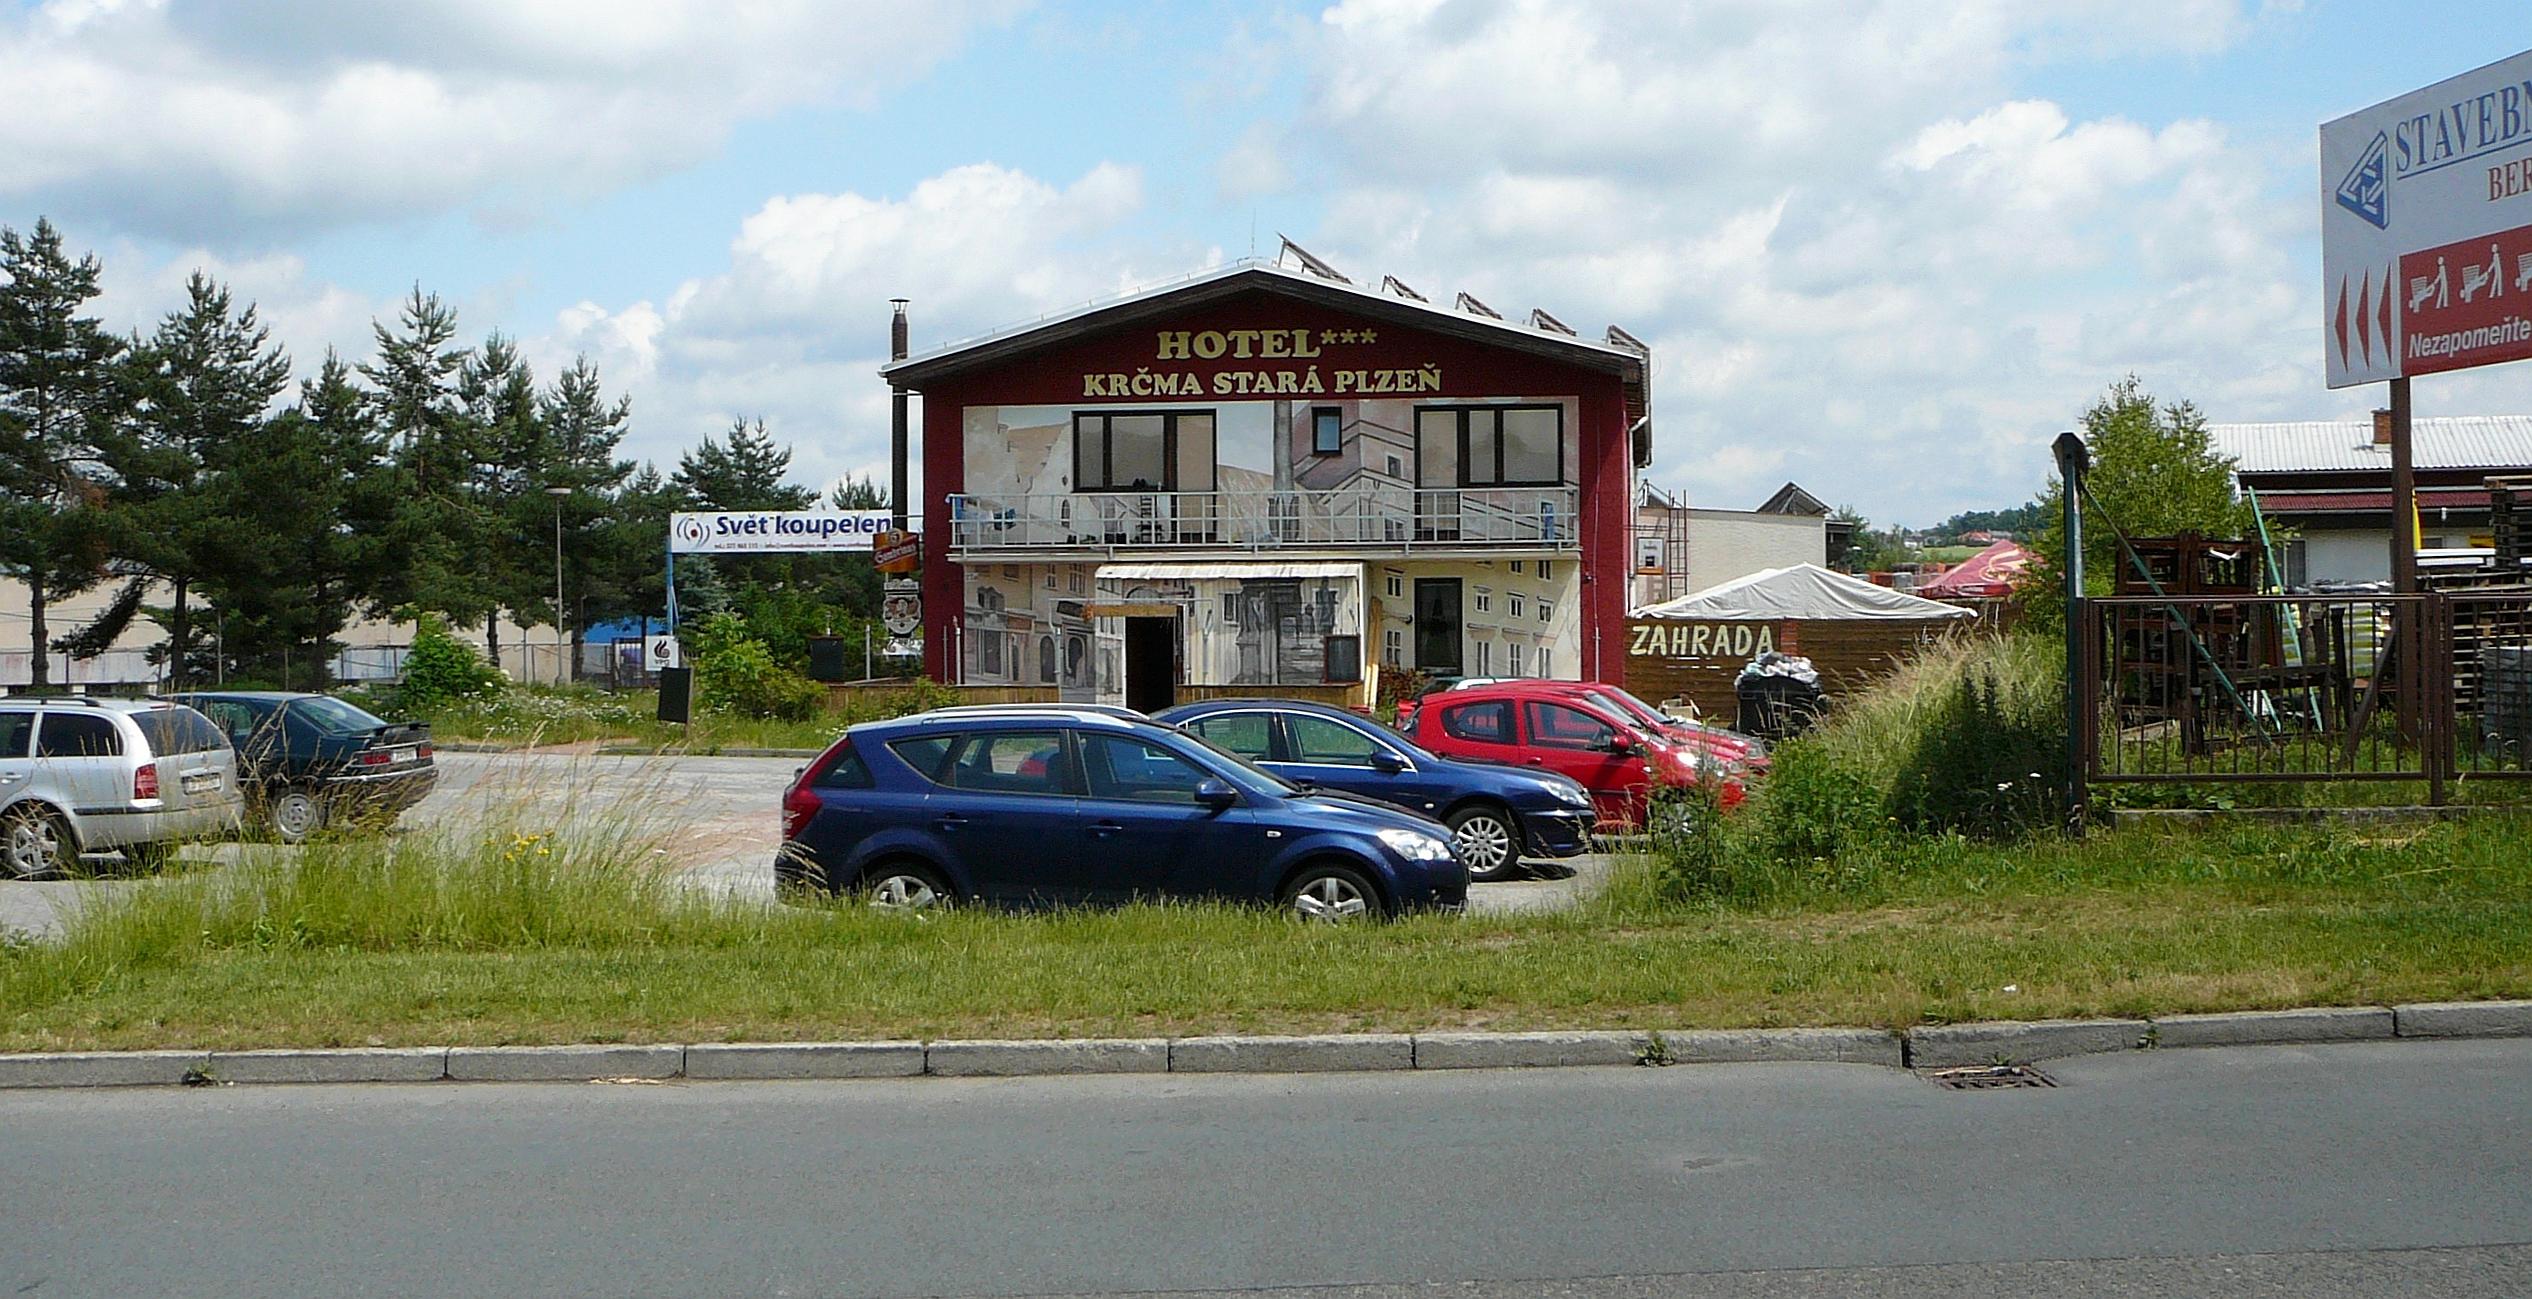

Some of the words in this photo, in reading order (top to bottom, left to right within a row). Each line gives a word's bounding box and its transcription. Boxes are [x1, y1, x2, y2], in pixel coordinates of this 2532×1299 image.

[1156, 329, 1321, 360] HOTEL
[2408, 316, 2532, 359] Nezapomeňte
[1083, 366, 1204, 396] KRČMA
[1212, 365, 1325, 395] STARÁ
[1333, 362, 1442, 393] PLZEŇ
[716, 514, 768, 535] Svět
[775, 514, 891, 539] koupelen
[1630, 624, 1775, 657] ZAHRADA
